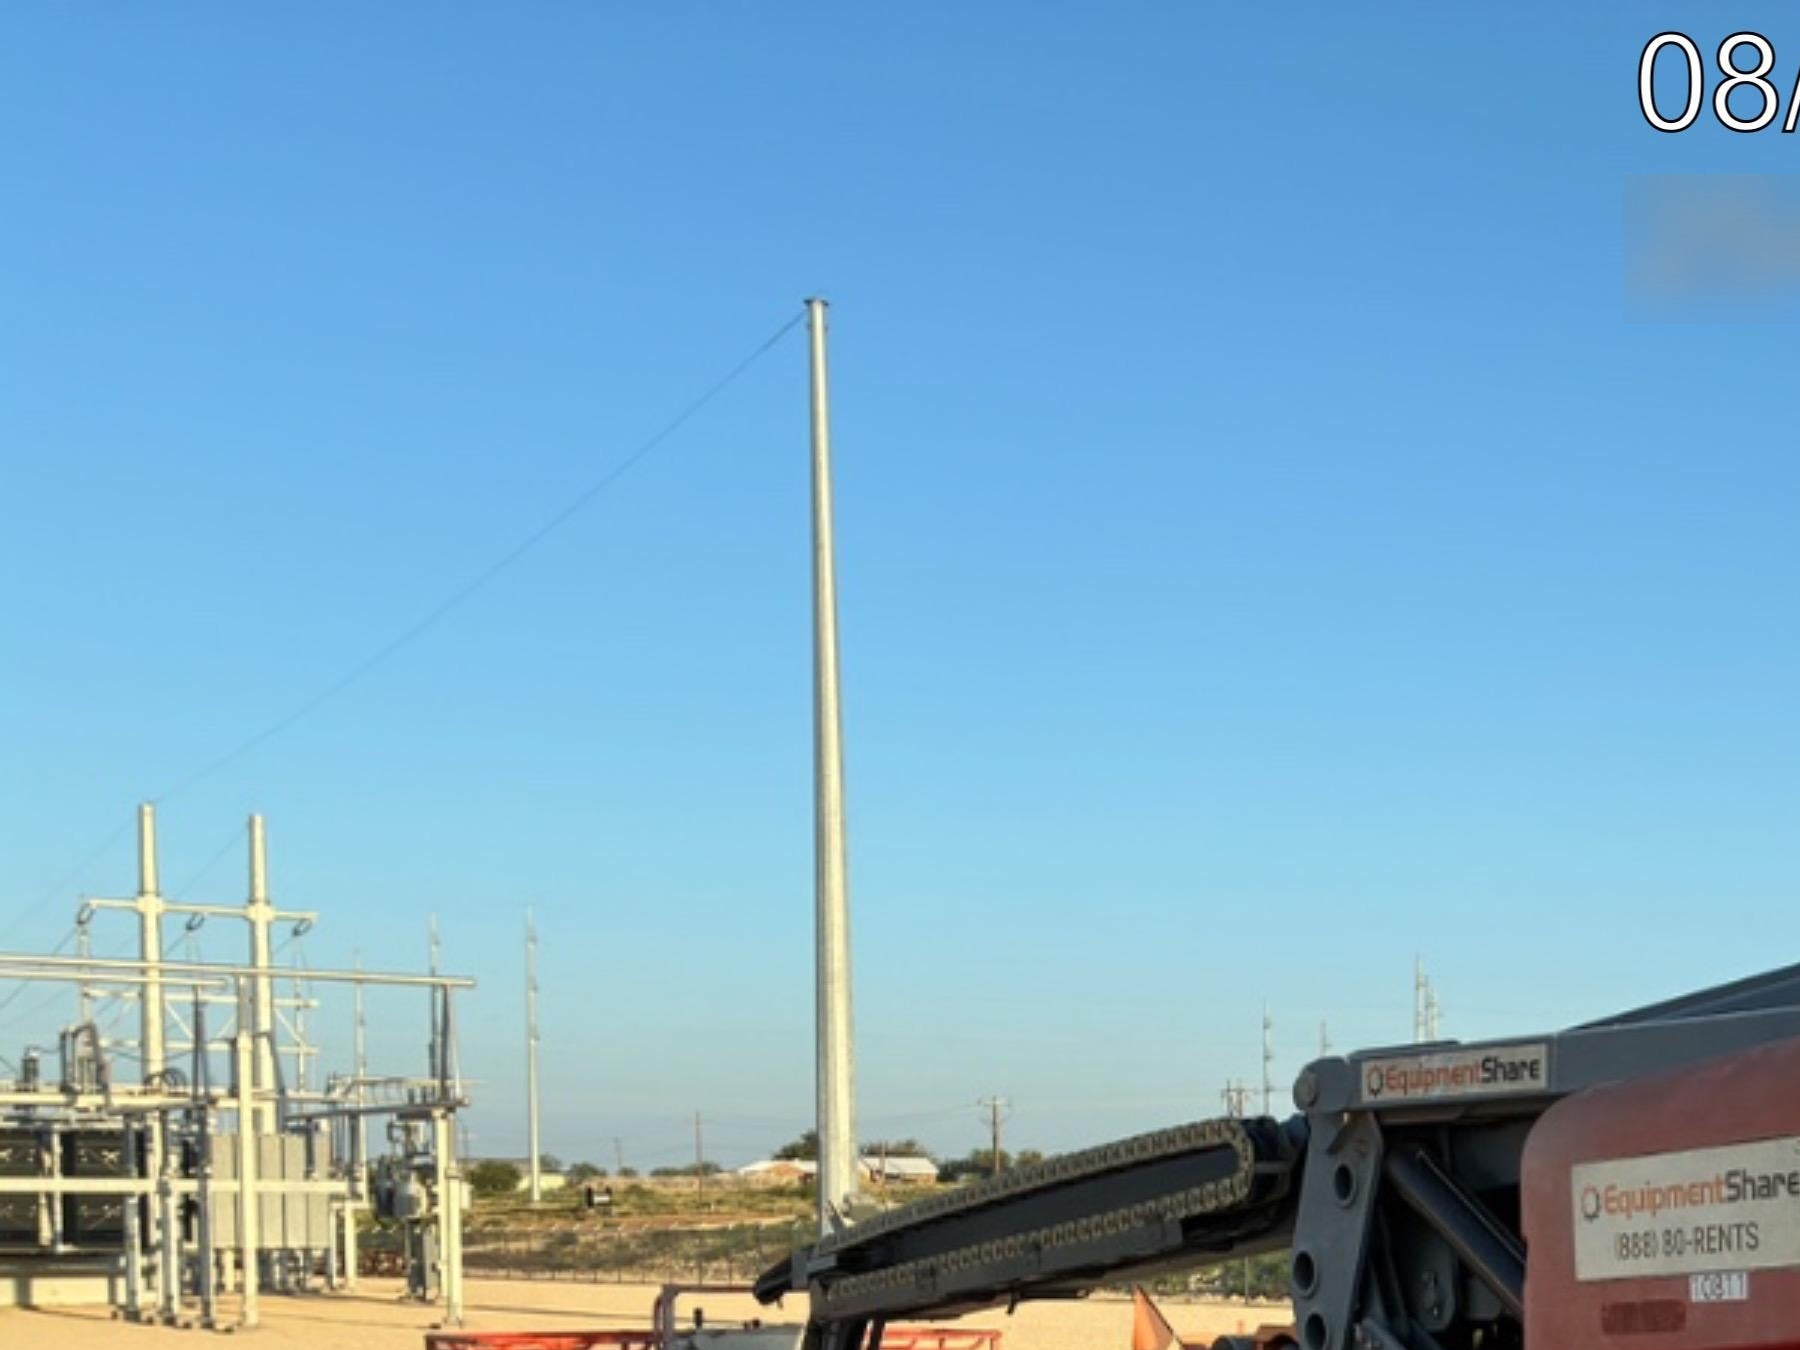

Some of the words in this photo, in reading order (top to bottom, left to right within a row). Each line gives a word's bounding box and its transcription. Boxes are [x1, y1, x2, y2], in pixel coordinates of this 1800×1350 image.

[1385, 1056, 1541, 1096] EquipmentShare
[1603, 1168, 1800, 1220] EquipmentShare
[1662, 1221, 1759, 1256] 80-RENTS
